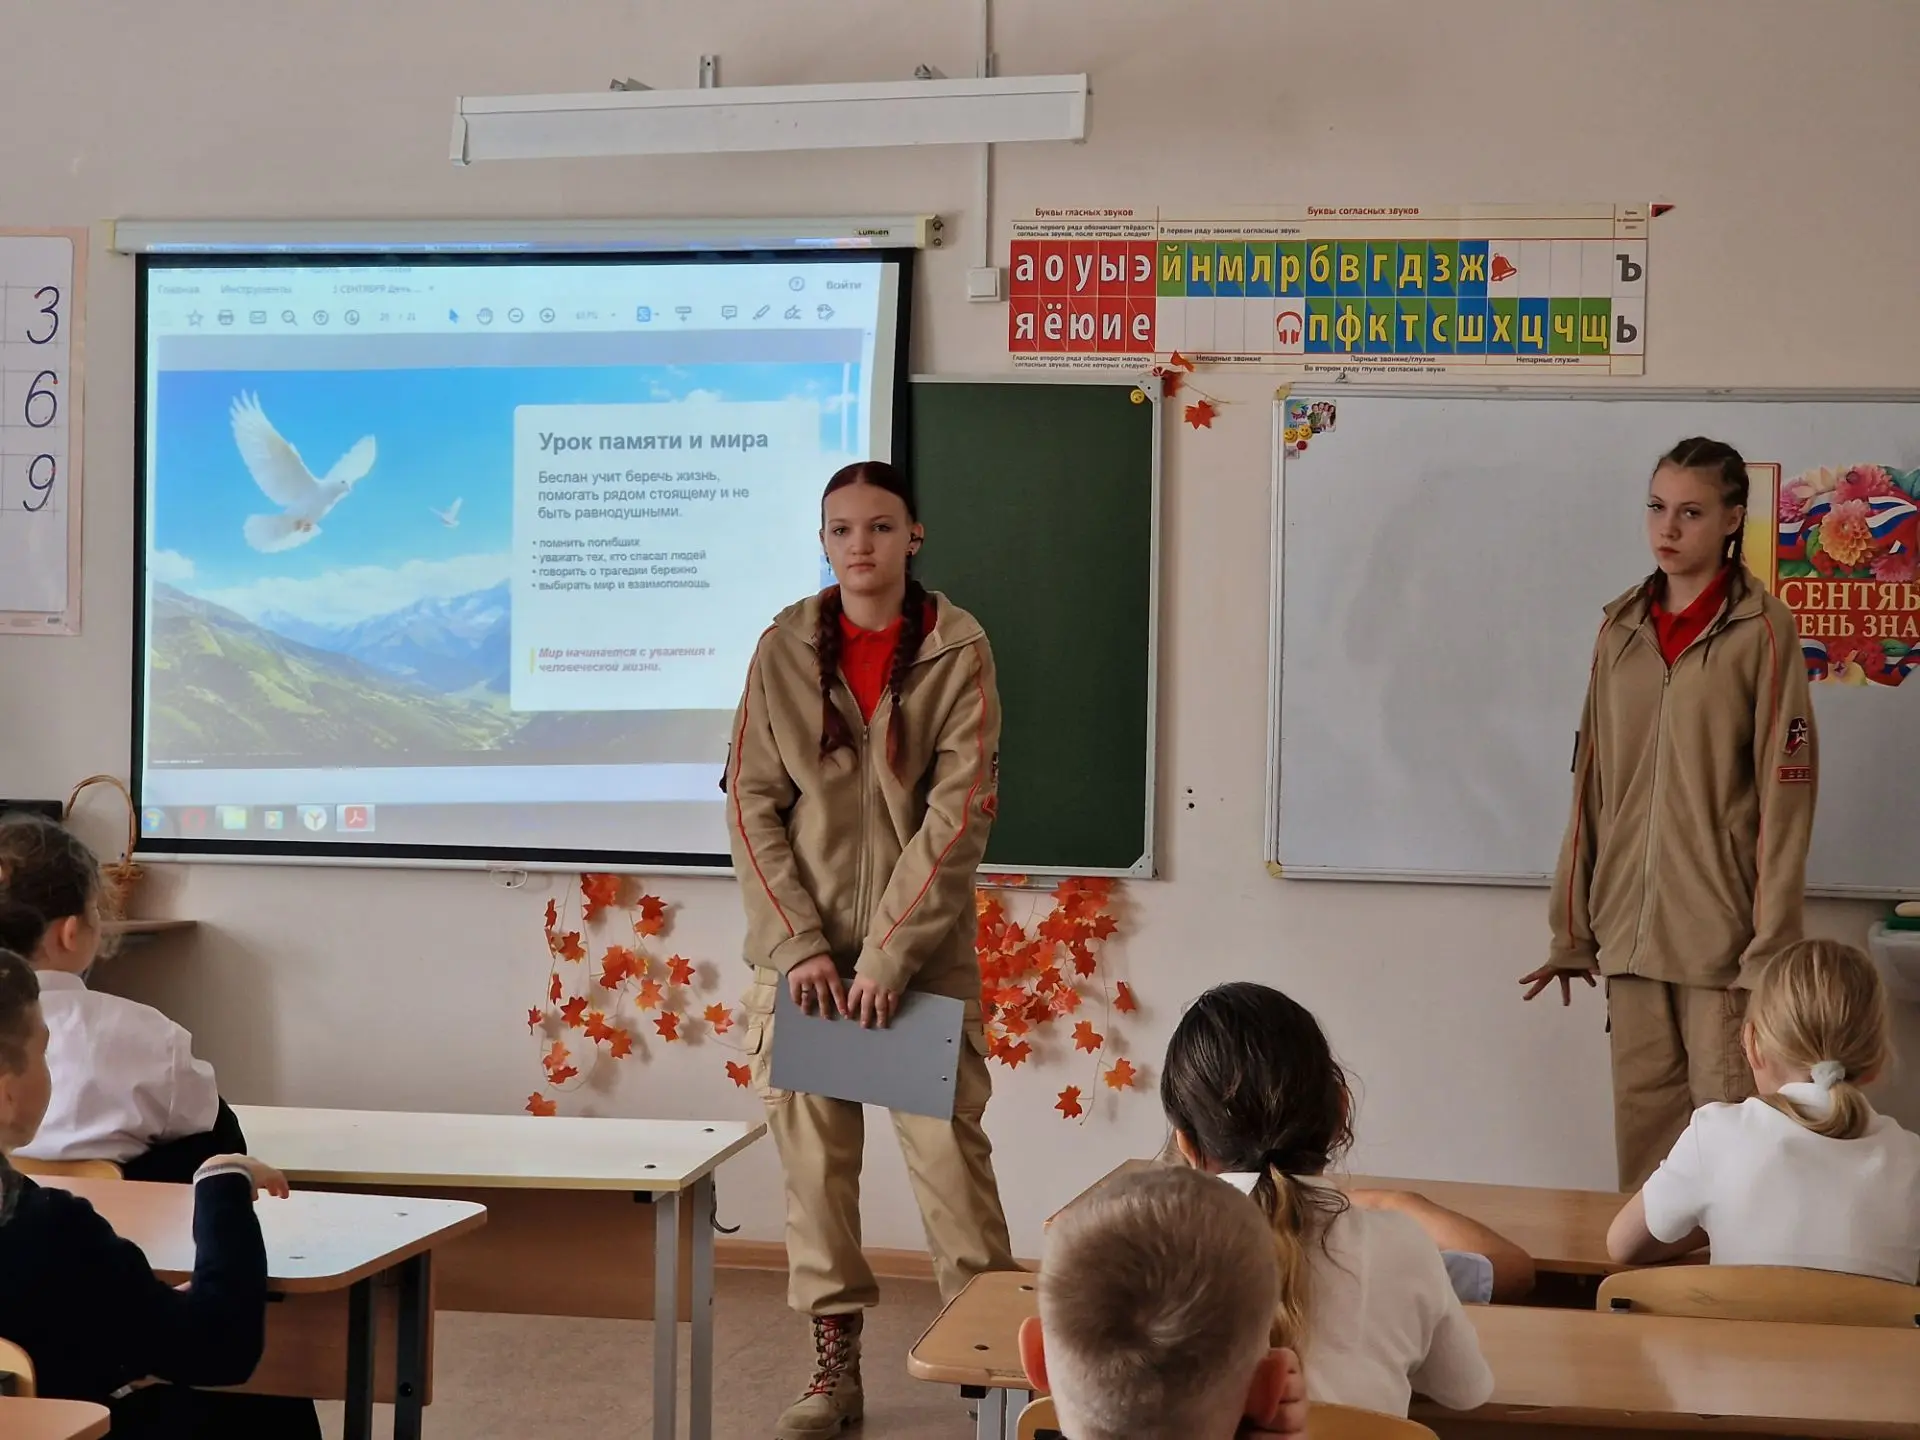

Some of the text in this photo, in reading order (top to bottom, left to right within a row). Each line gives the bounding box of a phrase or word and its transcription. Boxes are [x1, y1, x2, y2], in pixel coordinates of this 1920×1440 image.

[1035, 208, 1133, 218] Буквы гласных звуков
[1307, 206, 1336, 216] Буквы
[1388, 207, 1419, 216] звуков
[1013, 223, 1039, 231] Гласные
[1016, 254, 1034, 281] а
[1044, 254, 1064, 282] о
[1074, 254, 1093, 292] у
[1100, 254, 1125, 282] ы
[1134, 255, 1152, 282] э
[1162, 245, 1181, 281] й
[1191, 255, 1211, 282] н
[1218, 255, 1243, 282] м
[1251, 255, 1271, 282] л
[1280, 255, 1300, 293] р
[1310, 244, 1330, 282] б
[1341, 254, 1360, 282] в
[1373, 254, 1388, 281] г
[1400, 254, 1423, 288] д
[1434, 254, 1450, 282] з
[1460, 255, 1485, 281] ж
[826, 280, 862, 290] Войти
[26, 285, 60, 345] 3
[1015, 312, 1034, 340] я
[1044, 304, 1063, 340] ё
[1069, 312, 1095, 341] ю
[1102, 313, 1121, 340] и
[1132, 313, 1151, 341] е
[1309, 314, 1328, 341] п
[1336, 304, 1362, 351] ф
[1370, 314, 1387, 342] к
[1402, 314, 1419, 341] т
[1432, 314, 1448, 342] с
[1458, 315, 1483, 342] ш
[1494, 315, 1511, 342] х
[1522, 316, 1543, 349] ц
[1554, 315, 1574, 343] ч
[1581, 315, 1608, 350] щ
[1196, 355, 1232, 363] Непарные
[1350, 355, 1378, 363] Парные
[1516, 356, 1580, 365] Непарные глухие
[24, 369, 59, 428] 6
[539, 432, 769, 455] Урок памяти и мира
[22, 453, 57, 513] 9
[538, 470, 721, 486] Беслан учит беречь жизнь,
[538, 487, 750, 503] помогать рядом стоящему и не
[538, 506, 683, 521] быть равнодушными.
[539, 537, 641, 549] помнить погибших
[539, 550, 707, 564] уважать тех, кто спасал людей
[539, 565, 698, 579] говорить о трагедии бережно
[538, 579, 711, 592] выбирать мир и взаимопомощь
[1796, 613, 1855, 637] ЕНЬ
[538, 647, 716, 660] Мир начинается с уважения к
[538, 661, 619, 673] человеческой
